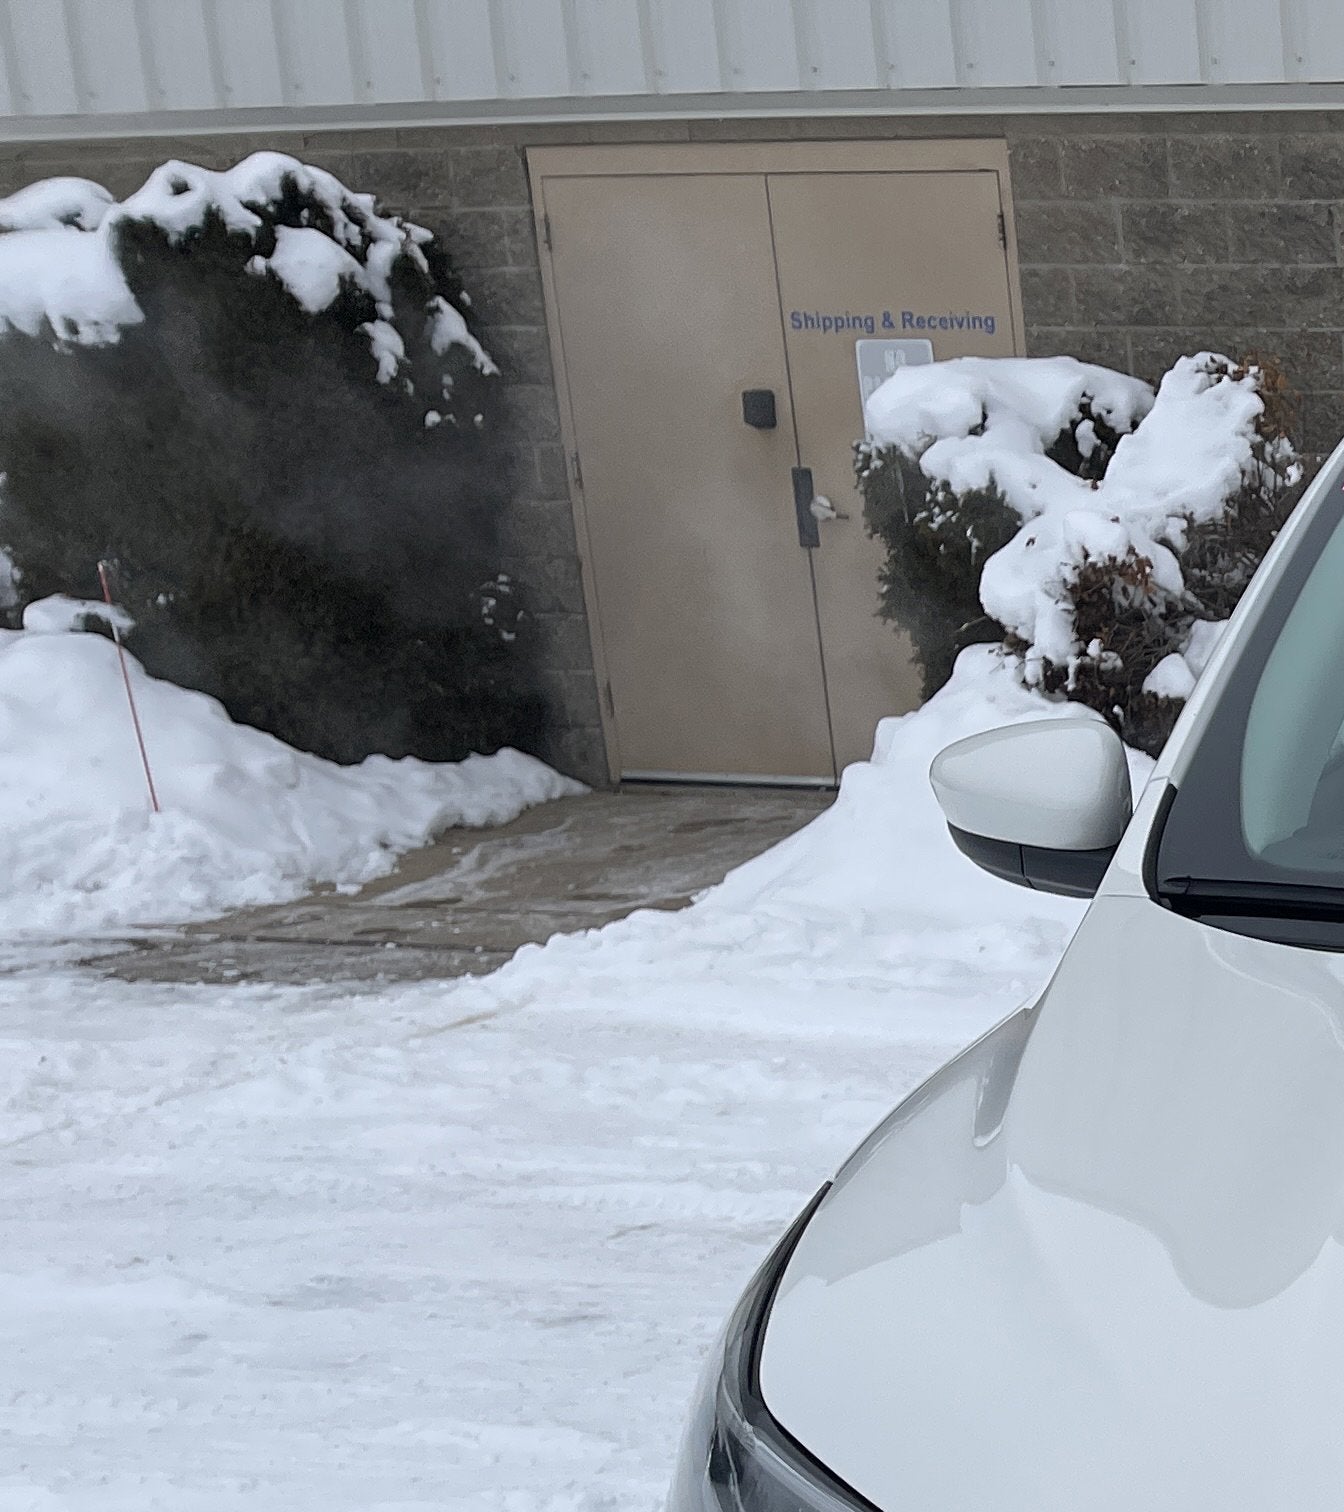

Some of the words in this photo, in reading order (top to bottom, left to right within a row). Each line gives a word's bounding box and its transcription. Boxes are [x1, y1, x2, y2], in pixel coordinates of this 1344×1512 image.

[790, 310, 875, 335] Shipping
[881, 310, 896, 330] &
[901, 310, 997, 335] Receiving
